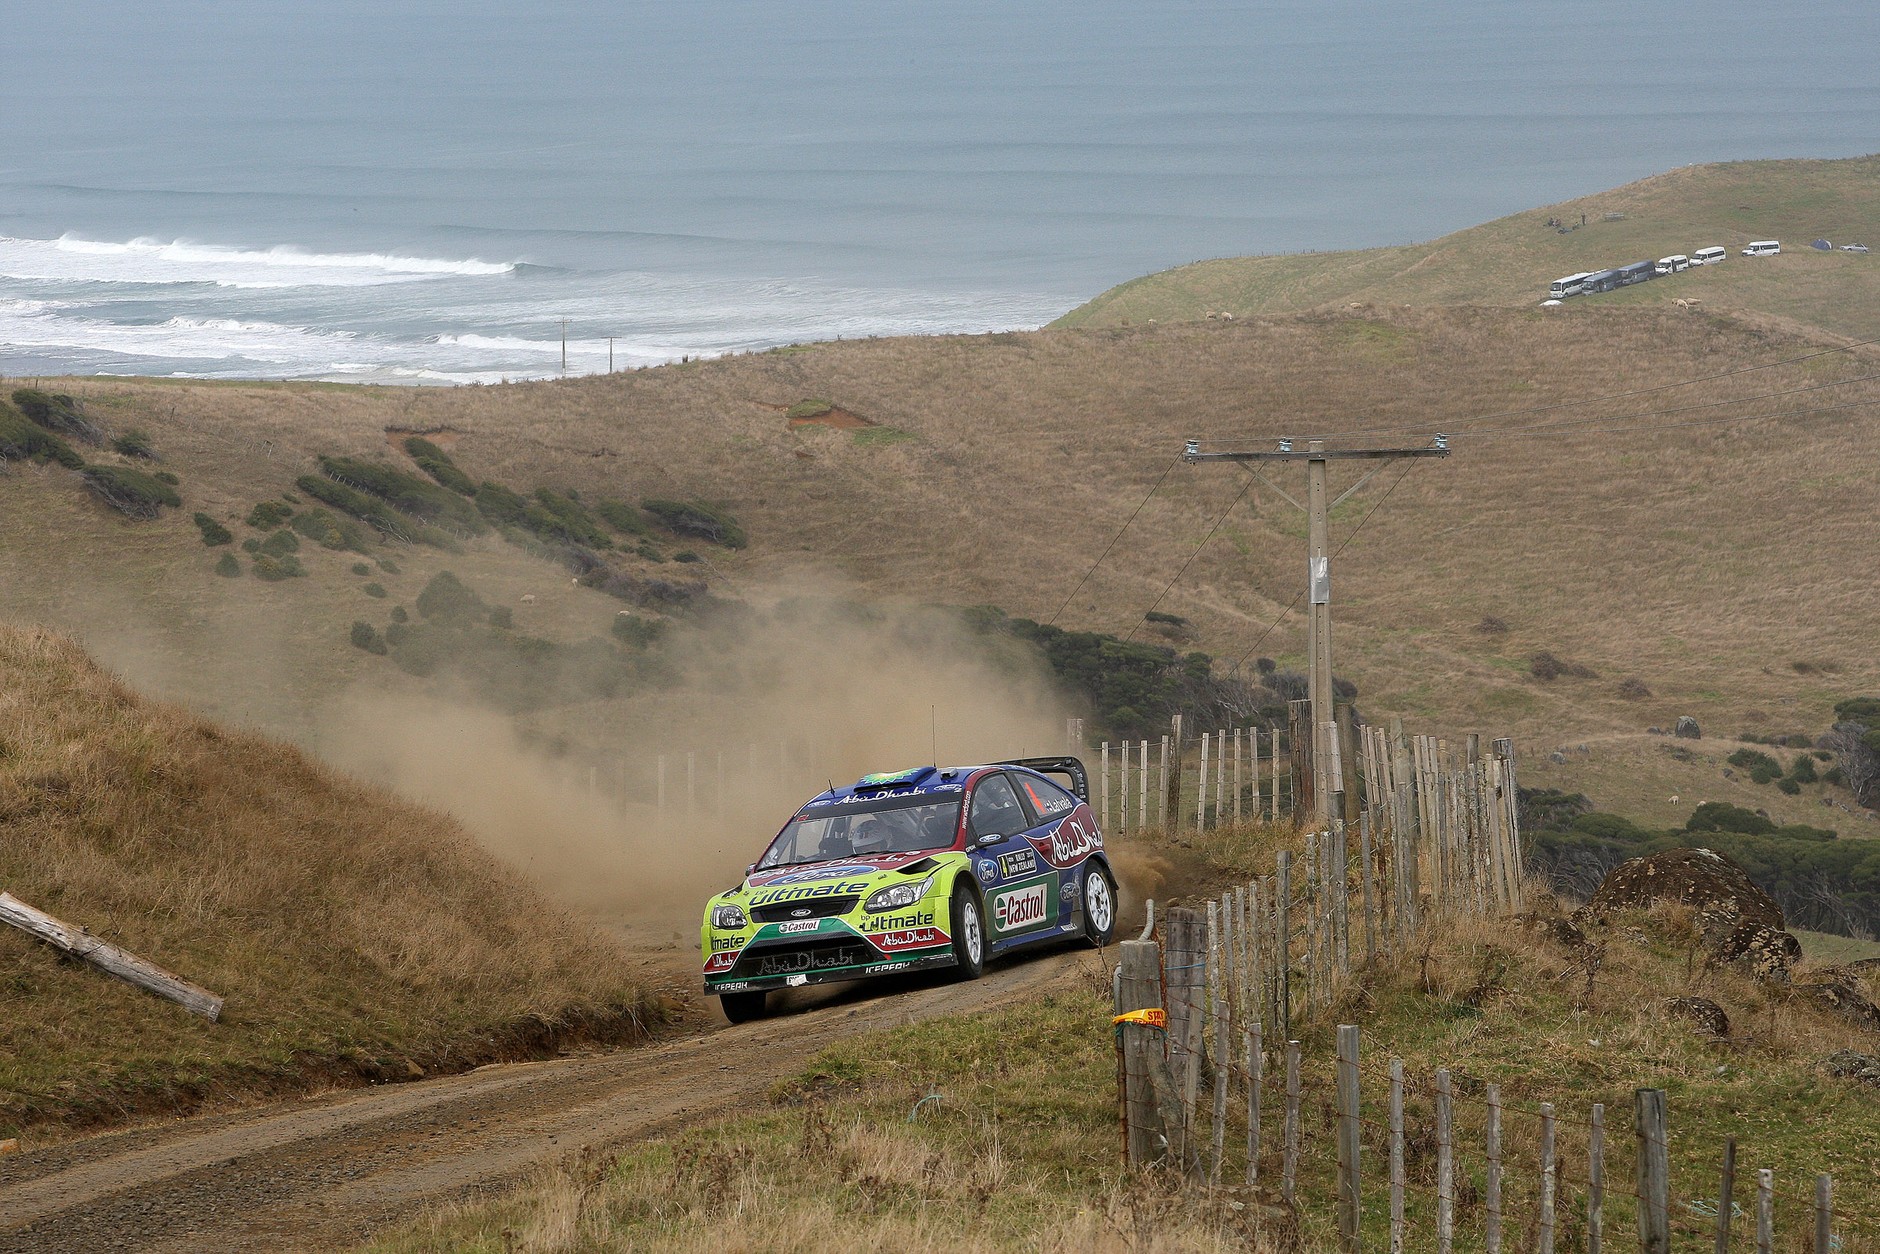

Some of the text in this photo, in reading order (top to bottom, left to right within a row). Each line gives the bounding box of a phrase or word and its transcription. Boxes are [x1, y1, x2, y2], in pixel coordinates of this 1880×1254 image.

[979, 861, 996, 881] Ford
[1010, 859, 1035, 873] NEW ZEALAND
[749, 881, 869, 906] ultimate
[1007, 889, 1044, 926] Castrol
[787, 921, 817, 932] Castrol
[861, 914, 870, 922] bp
[861, 911, 934, 932] ultimate
